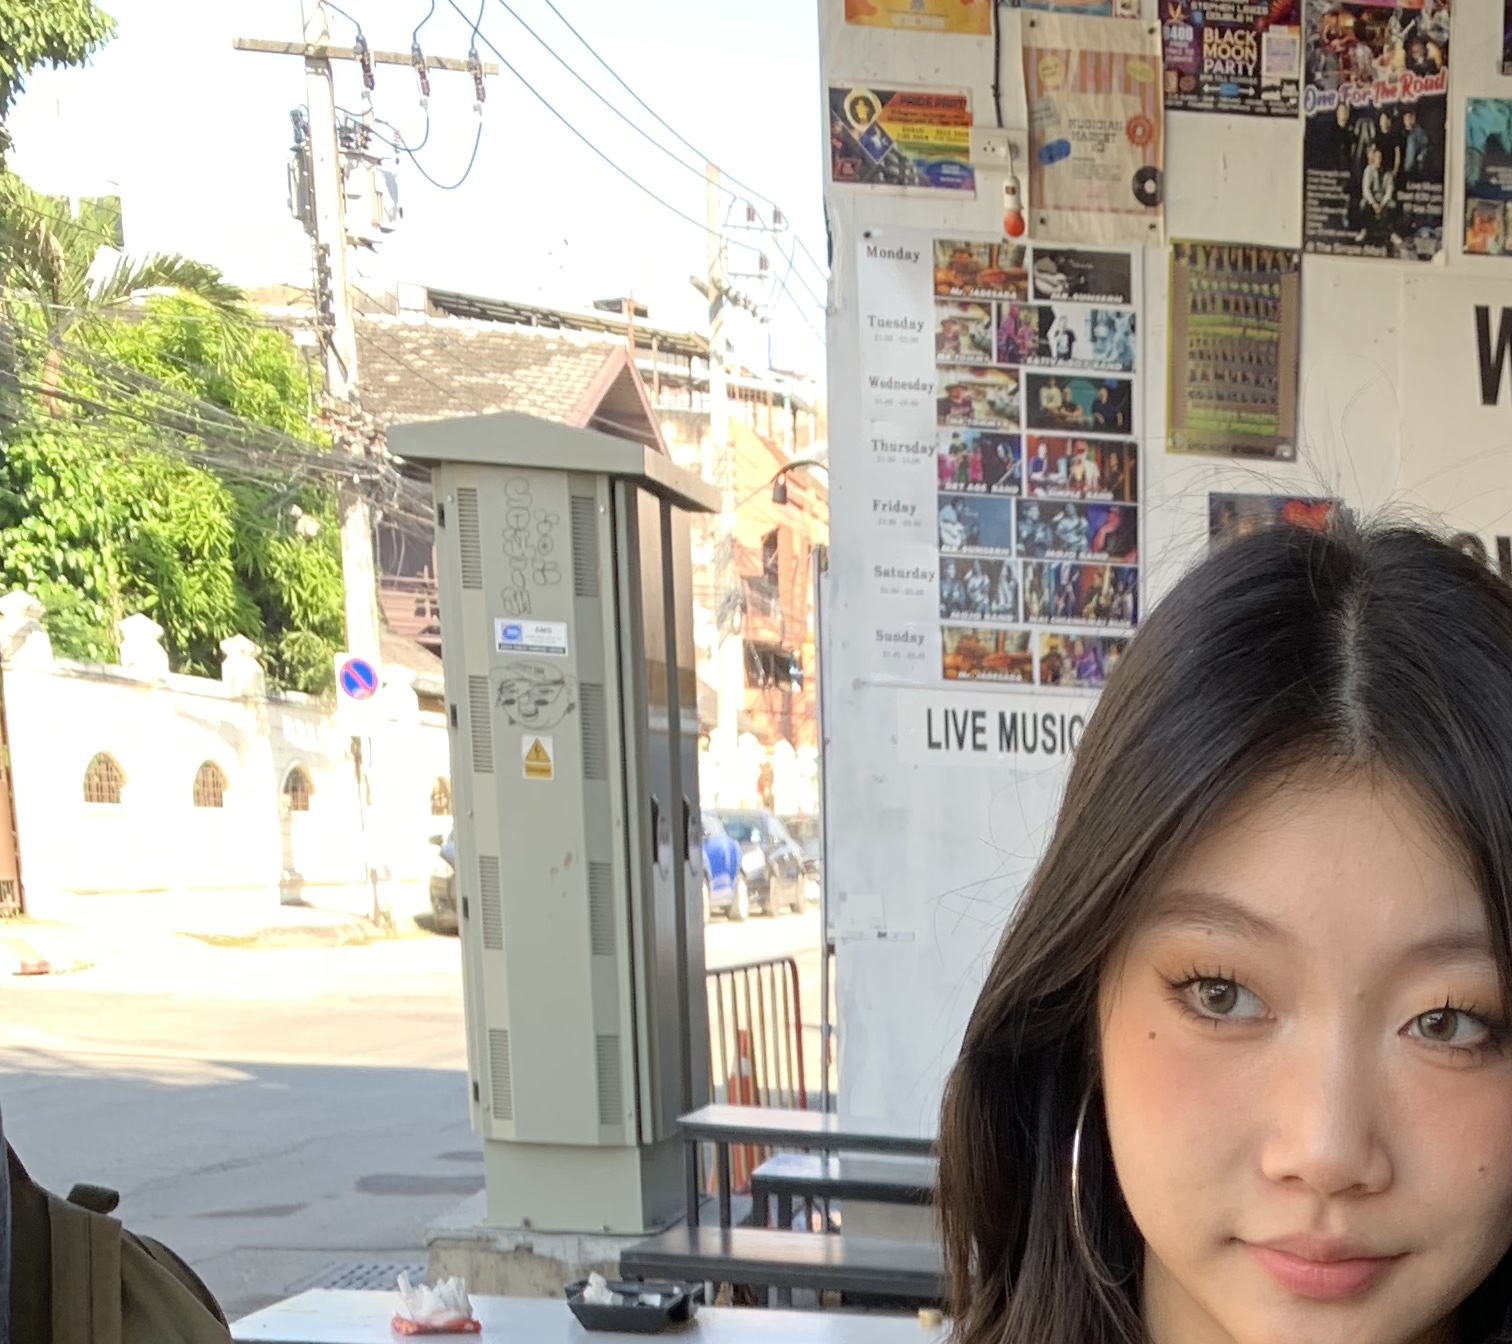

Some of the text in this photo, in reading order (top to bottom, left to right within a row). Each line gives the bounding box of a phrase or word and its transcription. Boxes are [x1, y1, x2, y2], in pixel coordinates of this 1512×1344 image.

[1203, 26, 1257, 46] BLACK
[1203, 43, 1258, 61] MOON
[1203, 58, 1257, 76] PARTY
[1304, 86, 1337, 113] One
[1339, 84, 1372, 104] For
[1373, 80, 1400, 105] The
[1402, 69, 1447, 99] Road
[866, 246, 921, 263] Monday
[867, 314, 925, 333] Tuesday
[868, 375, 935, 393] Wednesday
[870, 438, 936, 457] Thursday
[872, 499, 917, 516] Friday
[874, 565, 935, 582] Saturday
[875, 629, 925, 645] Sunday
[927, 708, 988, 752] LIVE
